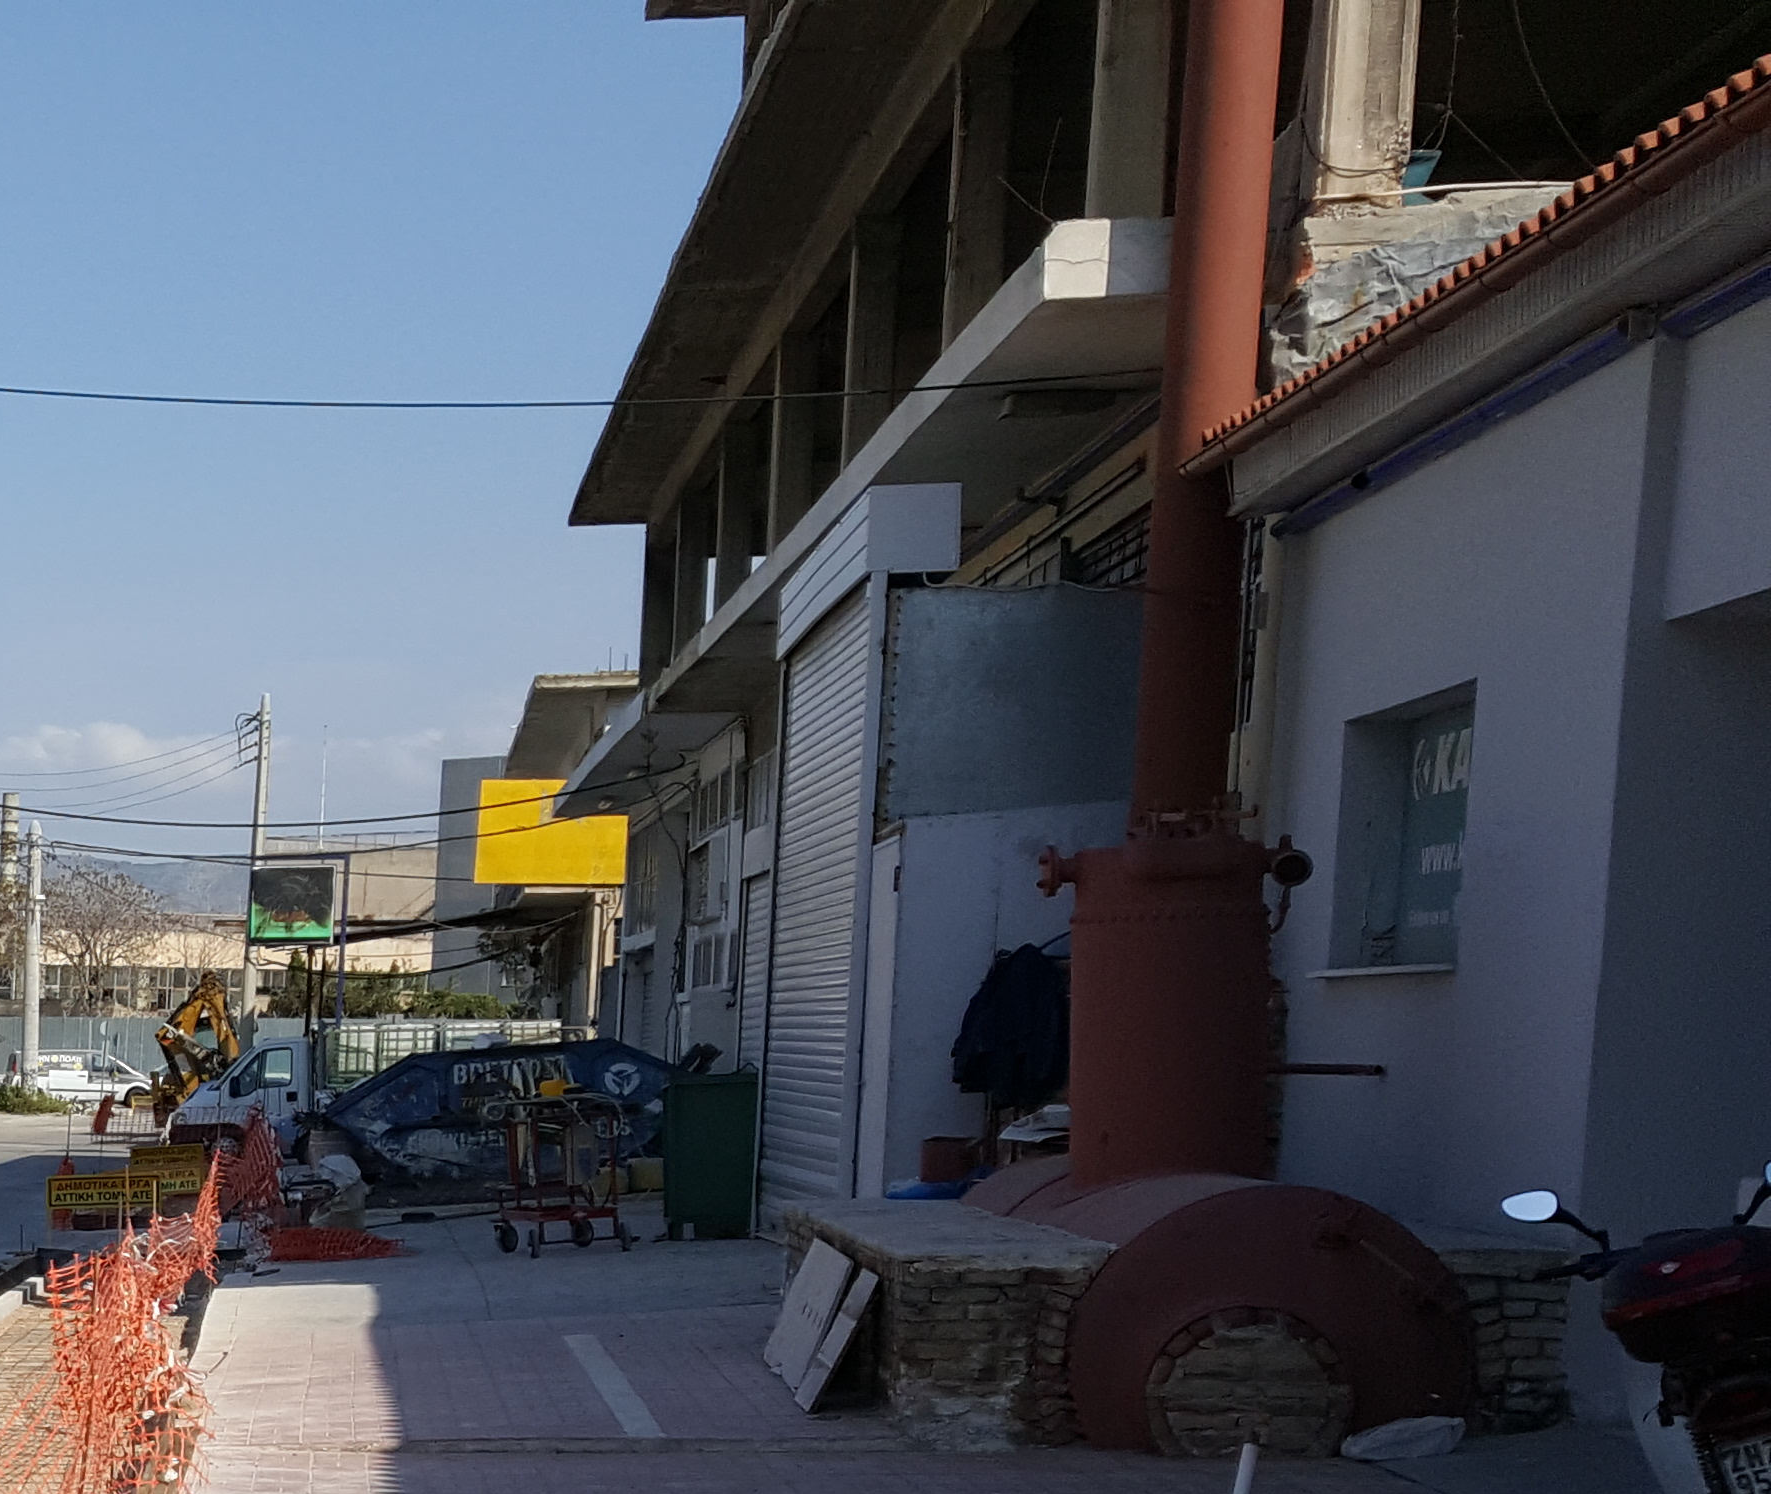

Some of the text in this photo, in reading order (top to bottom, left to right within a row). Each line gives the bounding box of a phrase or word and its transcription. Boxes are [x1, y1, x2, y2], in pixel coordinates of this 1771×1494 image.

[56, 1180, 117, 1192] ΔΗΜΟΤΙΚΑ
[179, 1179, 197, 1189] ΑΤΕ
[54, 1191, 94, 1203] ΑΤΤΙΚΗ
[131, 1190, 153, 1201] ΑΤΕ
